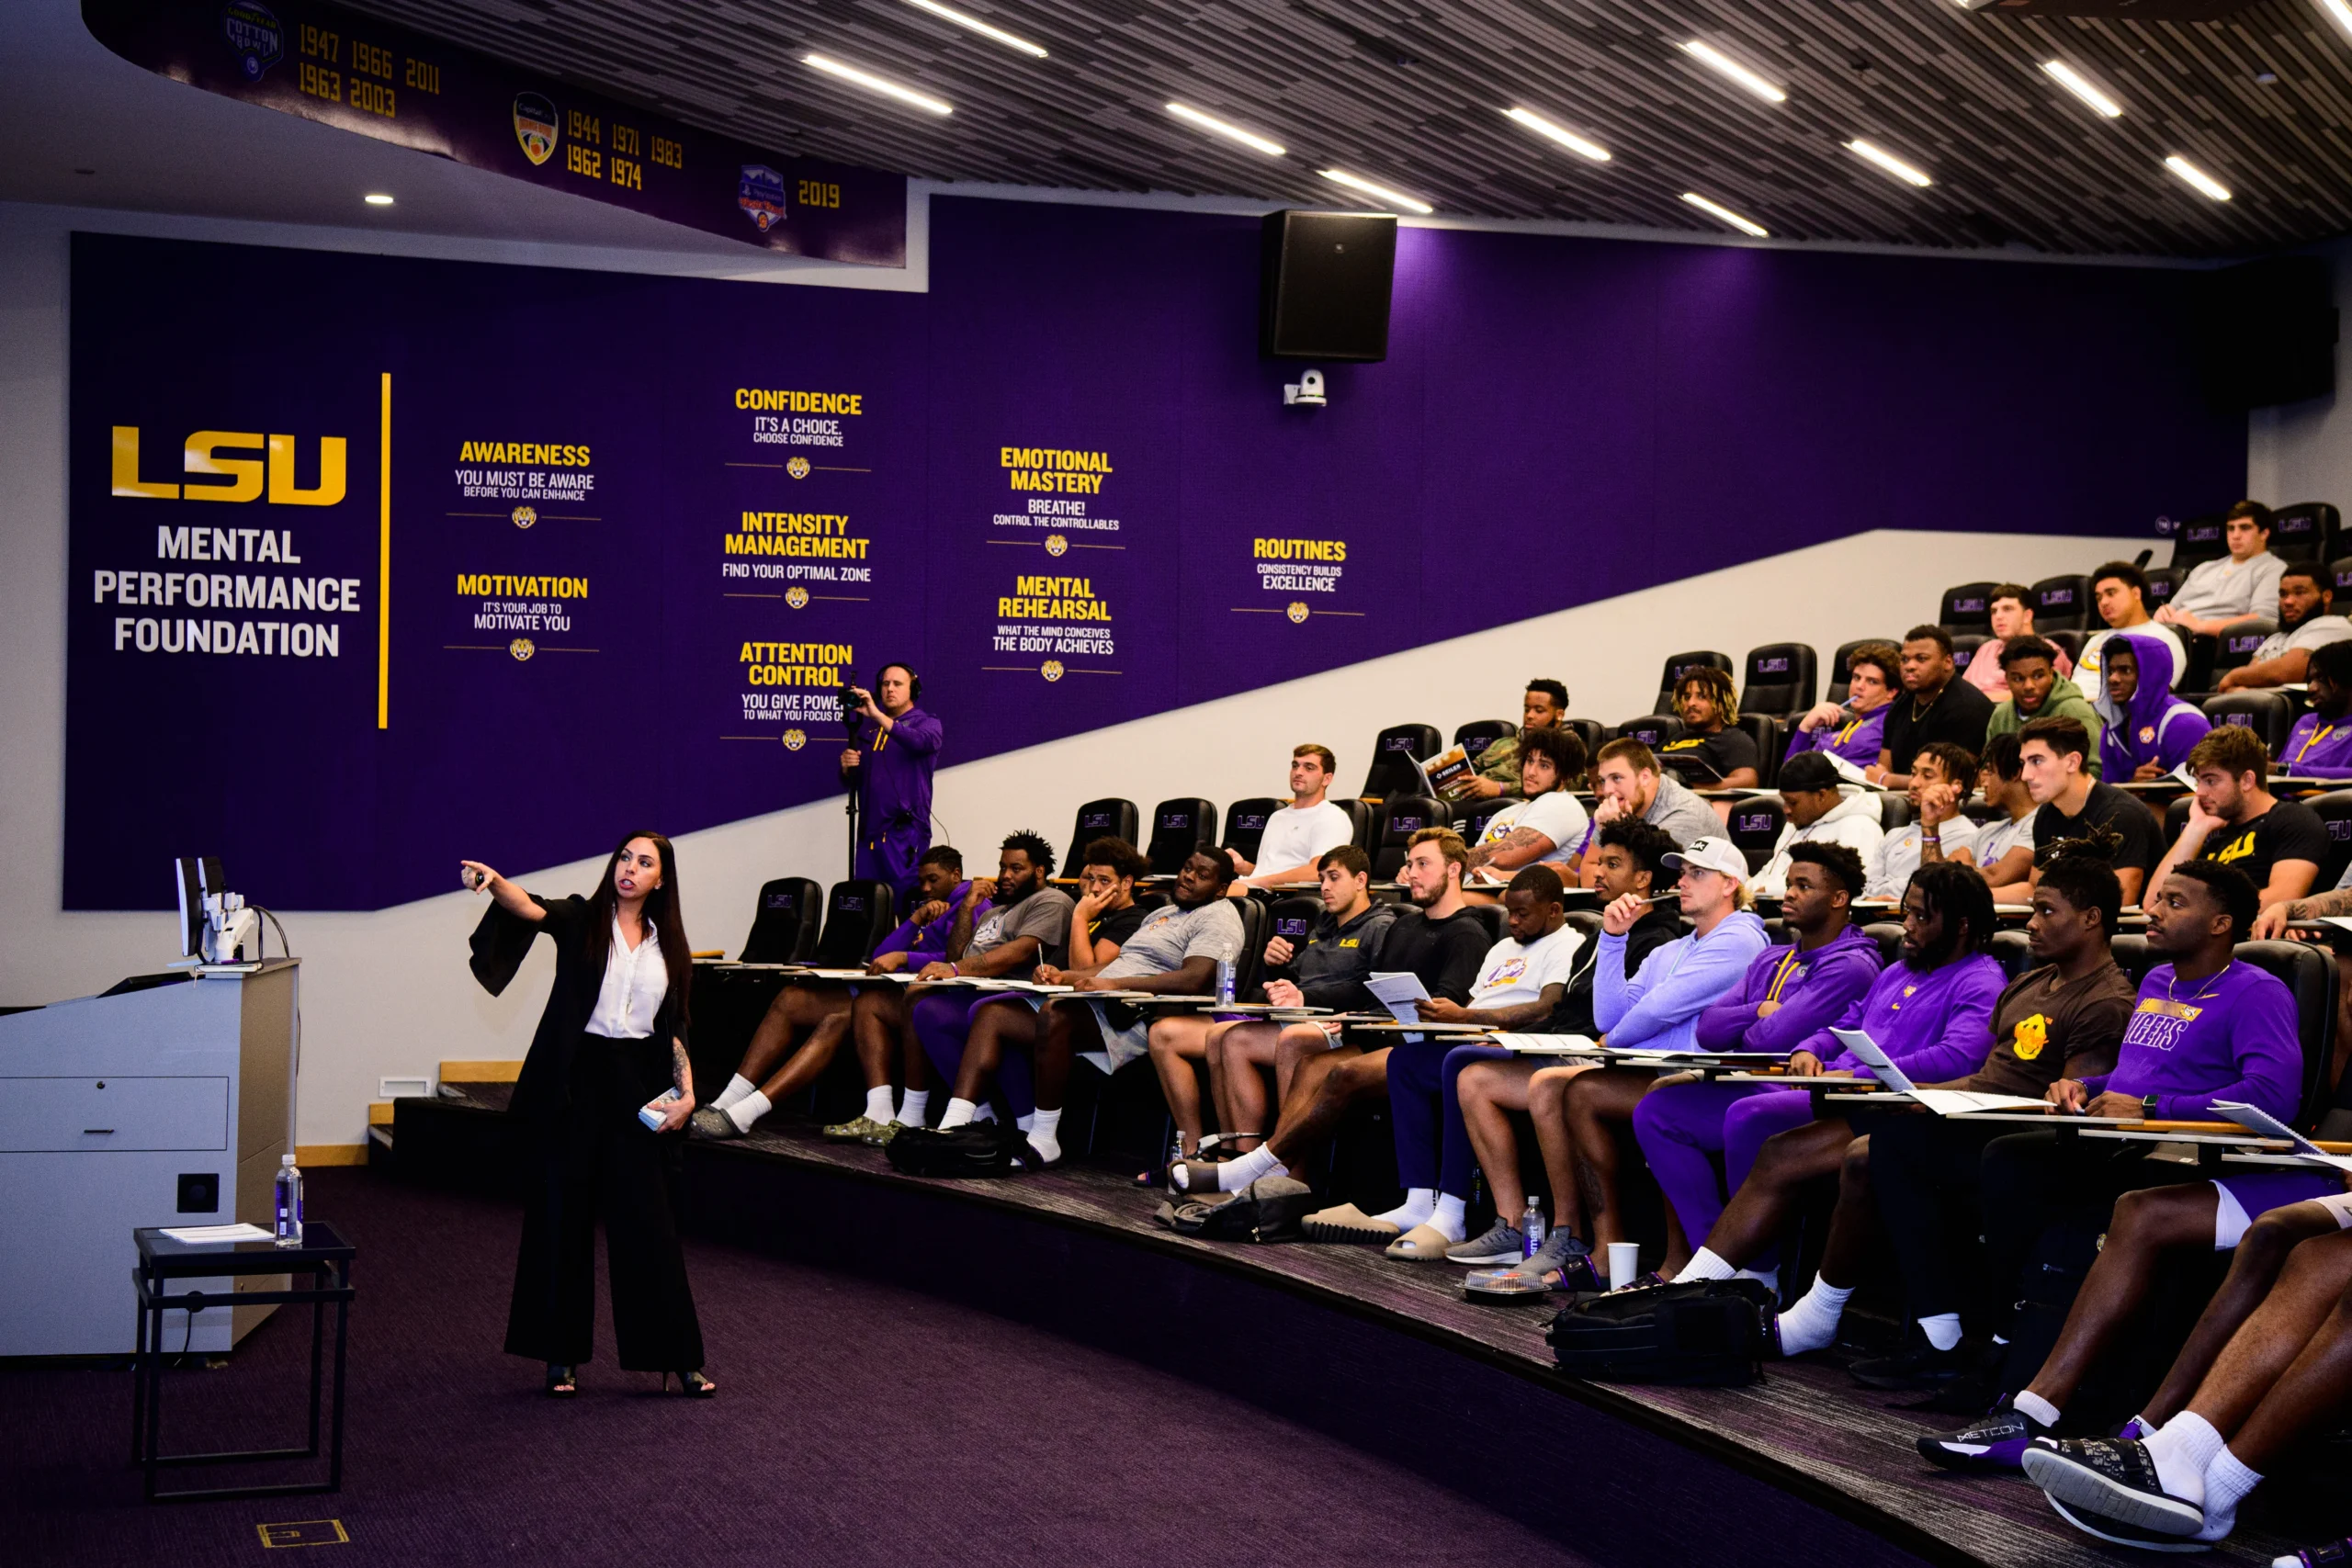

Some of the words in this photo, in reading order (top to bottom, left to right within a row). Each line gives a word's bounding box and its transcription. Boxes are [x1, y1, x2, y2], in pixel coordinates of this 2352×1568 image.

[226, 17, 277, 53] COTTON
[300, 24, 339, 62] 1947
[353, 40, 392, 80] 1966
[406, 58, 439, 95] 2011
[300, 62, 340, 102] 1963
[350, 77, 395, 118] 2003
[568, 110, 600, 144] 1944
[613, 123, 639, 156] 1971
[651, 136, 682, 169] 1983
[567, 143, 601, 178] 1962
[611, 157, 641, 190] 1974
[799, 180, 840, 209] 2019
[735, 389, 862, 415] CONFIDENCE
[755, 416, 778, 432] IT'S
[781, 418, 790, 433] A
[793, 419, 842, 434] CHOICE.
[753, 433, 788, 444] CHOOSE
[790, 434, 843, 446] CONFIDENCE
[459, 441, 590, 467] AWARENESS
[1001, 447, 1113, 473] EMOTIONAL
[112, 425, 346, 506] LSU
[455, 469, 482, 486] YOU
[486, 471, 526, 488] MUST
[528, 472, 545, 488] BE
[549, 474, 594, 491] AWARE
[1011, 470, 1103, 494] MASTERY
[464, 486, 499, 498] BEFORE
[501, 488, 520, 499] YOU
[522, 489, 540, 499] CAN
[543, 489, 584, 501] ENHANCE
[1028, 499, 1085, 516] BREATHE!
[742, 512, 849, 536] INTENSITY
[993, 514, 1032, 526] CONTROL
[1034, 516, 1049, 527] THE
[1051, 517, 1119, 531] CONTROLLABLES
[158, 525, 300, 564] MENTAL
[725, 534, 869, 558] MANAGEMENT
[1253, 538, 1347, 561] ROUTINES
[722, 563, 750, 577] FIND
[752, 564, 785, 579] YOUR
[786, 565, 838, 581] OPTIMAL
[841, 568, 871, 581] ZONE
[1257, 563, 1312, 576] CONSISTENCY
[1313, 566, 1342, 577] BUILDS
[95, 570, 360, 612] PERFORMANCE
[458, 574, 588, 598] MOTIVATION
[1017, 575, 1094, 598] MENTAL
[1262, 575, 1335, 592] EXCELLENCE
[483, 602, 500, 613] IT'S
[503, 603, 527, 614] YOUR
[529, 604, 548, 614] JOB
[549, 604, 561, 614] TO
[999, 597, 1112, 621] REHEARSAL
[474, 614, 540, 630] MOTIVATE
[543, 615, 571, 631] YOU
[998, 625, 1023, 636] WHAT
[1023, 626, 1039, 636] THE
[1041, 626, 1063, 637] MIND
[1065, 627, 1110, 639] CONCEIVES
[115, 617, 338, 657] FOUNDATION
[993, 636, 1016, 651] THE
[1020, 637, 1053, 652] BODY
[1055, 638, 1114, 655] ACHIEVES
[740, 642, 852, 665] ATTENTION
[1758, 658, 1788, 672] LSU
[749, 665, 843, 687] CONTROL
[741, 694, 768, 708] YOU
[771, 694, 800, 709] GIVE
[803, 695, 843, 711] POWE
[743, 710, 755, 720] TO
[757, 710, 783, 720] WHAT
[784, 711, 802, 720] YOU
[803, 711, 832, 721] FOCUS
[1385, 738, 1414, 750] LSU
[1084, 813, 1110, 829] LSU
[1162, 814, 1189, 829] LSU
[1237, 815, 1265, 829] LSU
[1393, 817, 1420, 831] LSU
[1740, 814, 1772, 831] LSU
[767, 894, 793, 908] LSU
[838, 896, 864, 911] LSU
[1277, 919, 1306, 935] LSU
[1339, 938, 1360, 948] LSU
[1957, 1422, 2024, 1442] METCON
